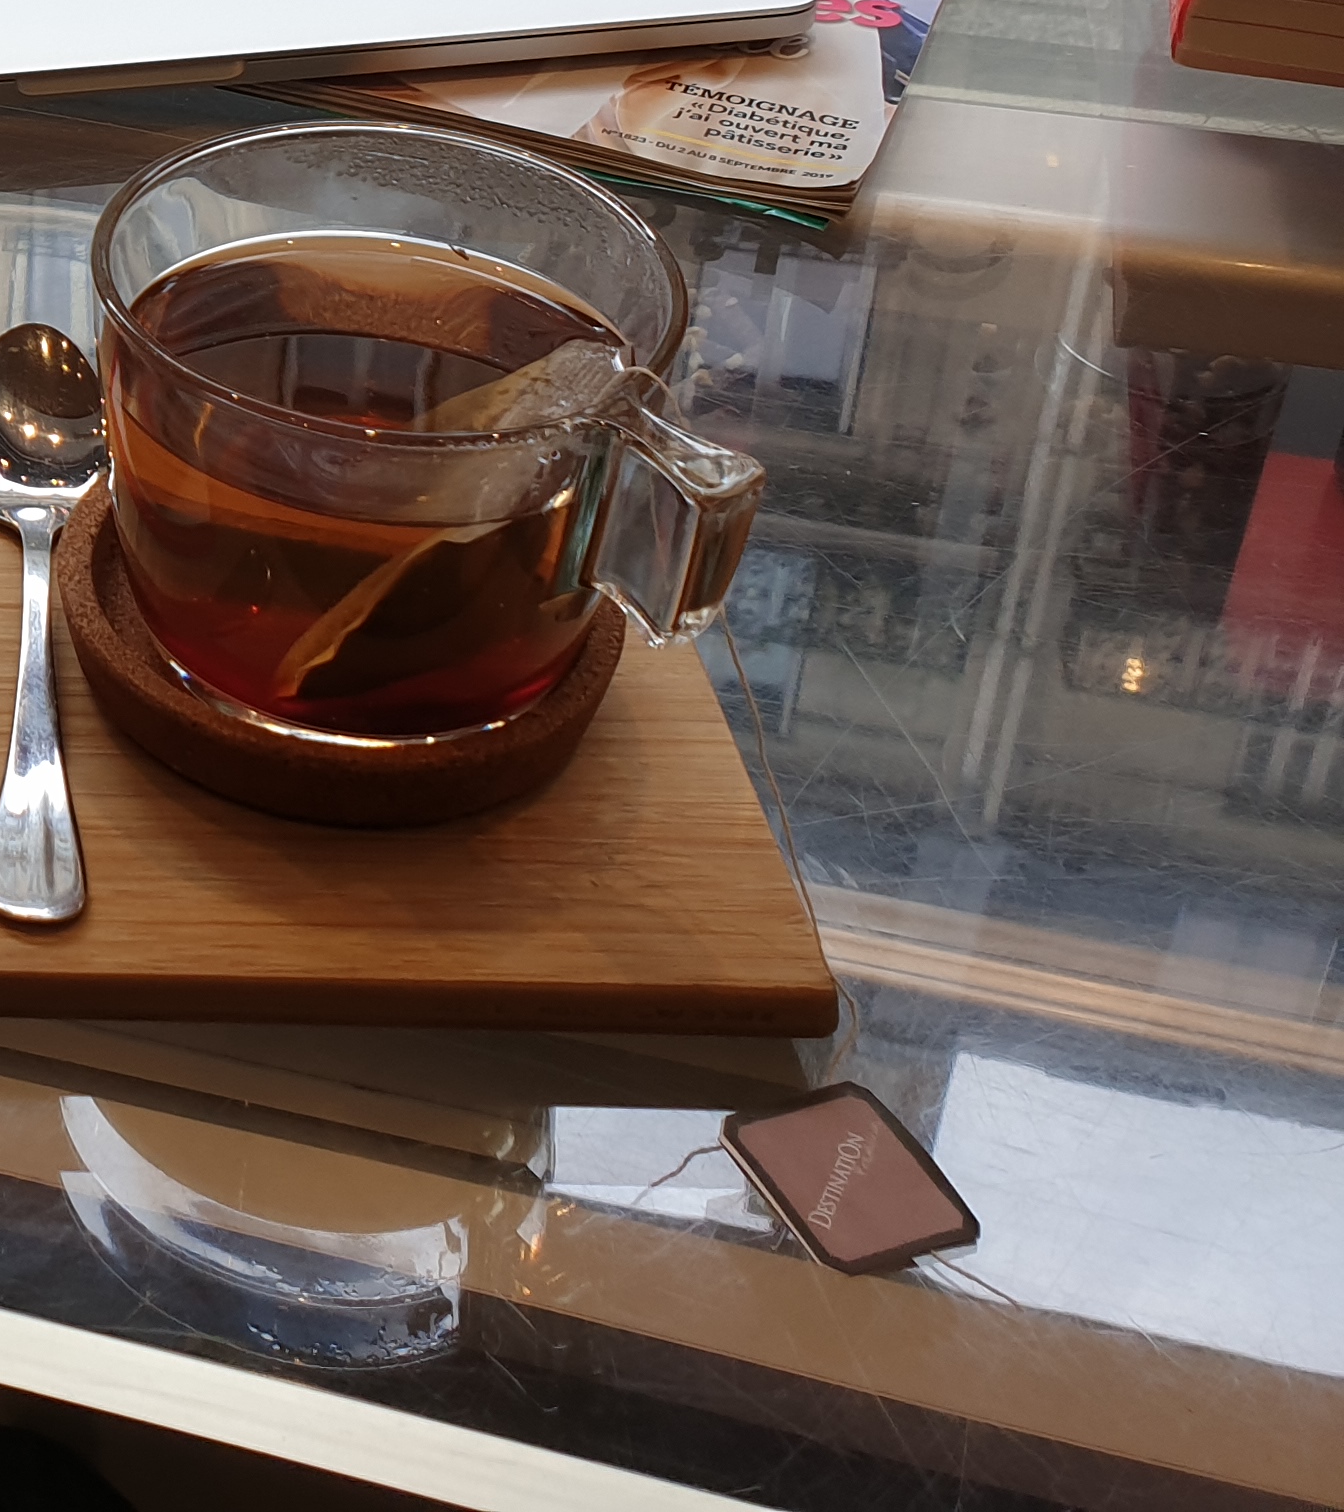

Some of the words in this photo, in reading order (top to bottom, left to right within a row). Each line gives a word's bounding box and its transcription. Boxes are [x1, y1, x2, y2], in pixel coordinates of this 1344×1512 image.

[664, 79, 861, 132] TÉMOIGNAGE
[672, 106, 712, 123] j'ai
[717, 117, 802, 145] ouvert
[809, 137, 849, 152] ma
[655, 139, 677, 152] DU
[687, 147, 708, 160] AU
[718, 155, 797, 176] SEPTEMBRE
[807, 1131, 867, 1231] DESTINATION
